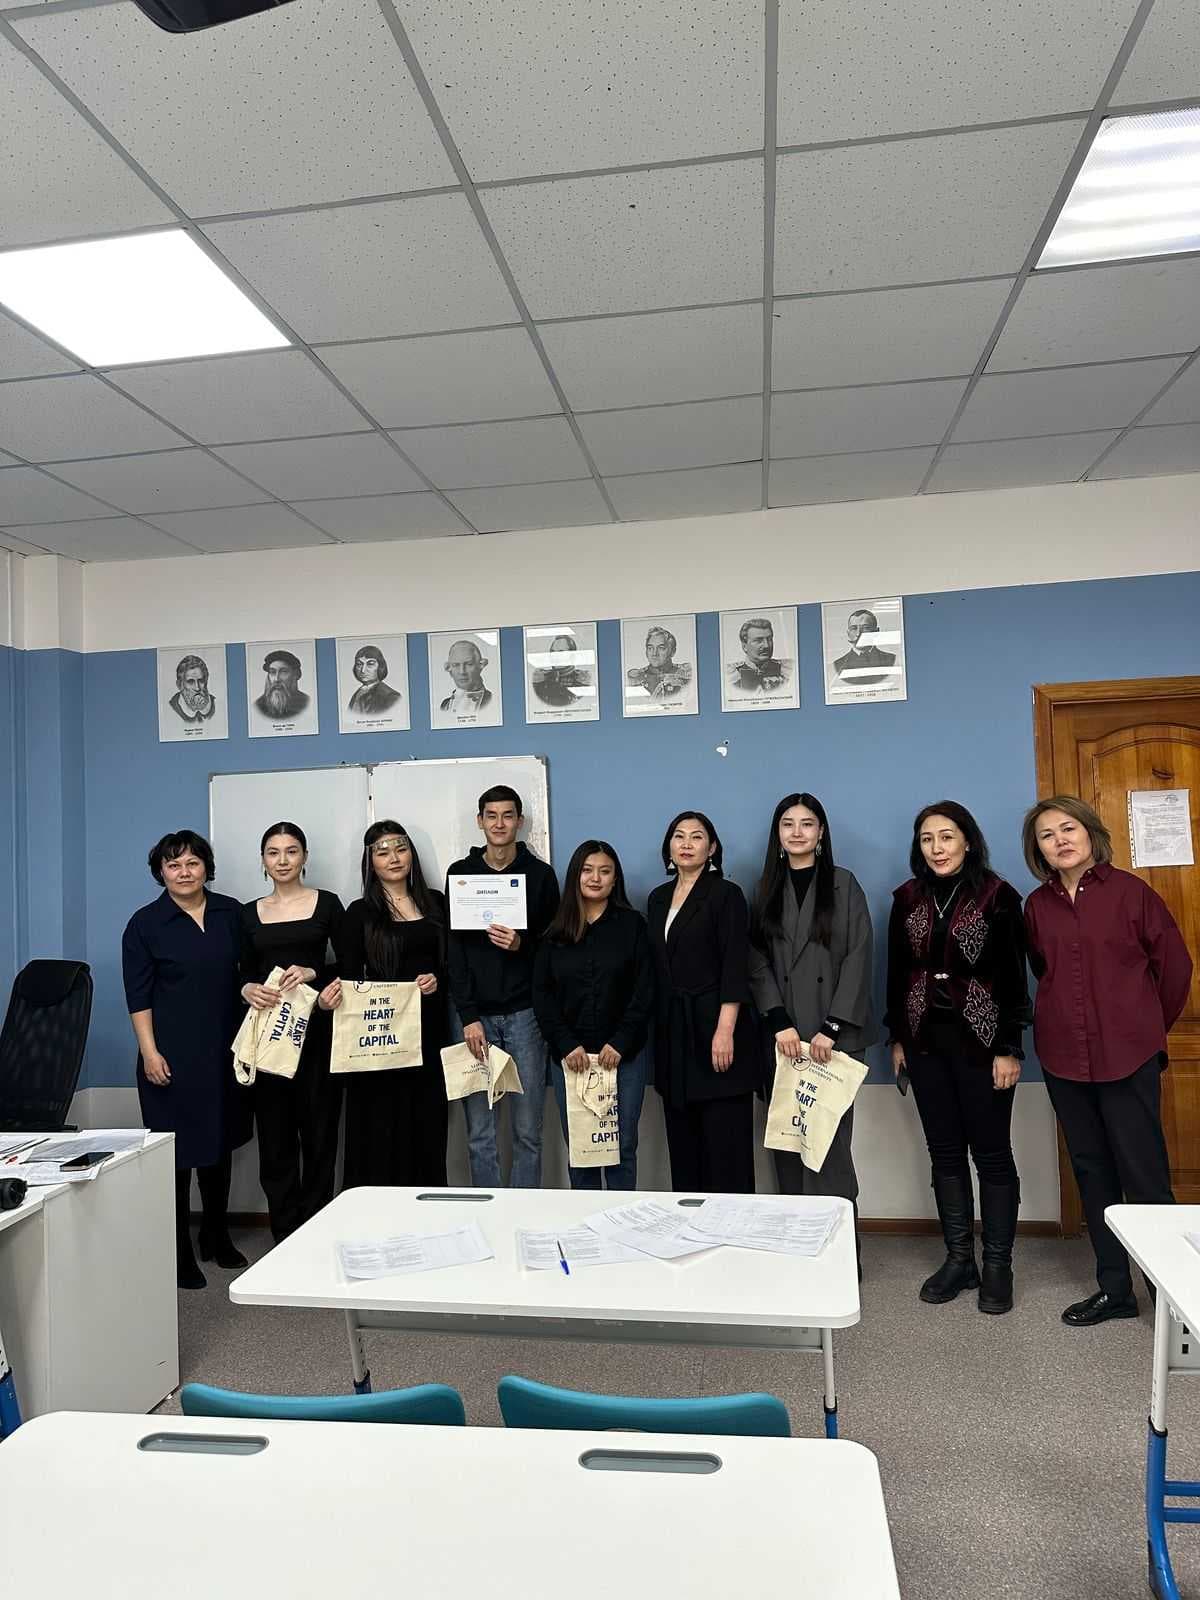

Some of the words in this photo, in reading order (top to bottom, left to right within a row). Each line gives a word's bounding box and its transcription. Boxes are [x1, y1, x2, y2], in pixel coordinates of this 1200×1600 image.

[379, 997, 391, 1005] THE
[363, 1008, 395, 1020] HEART
[269, 1001, 291, 1042] CAPITAL
[292, 1016, 308, 1048] HEART
[368, 1024, 377, 1032] OF
[359, 1034, 399, 1047] CAPITAL
[806, 1081, 818, 1094] THE
[599, 1120, 607, 1129] OF
